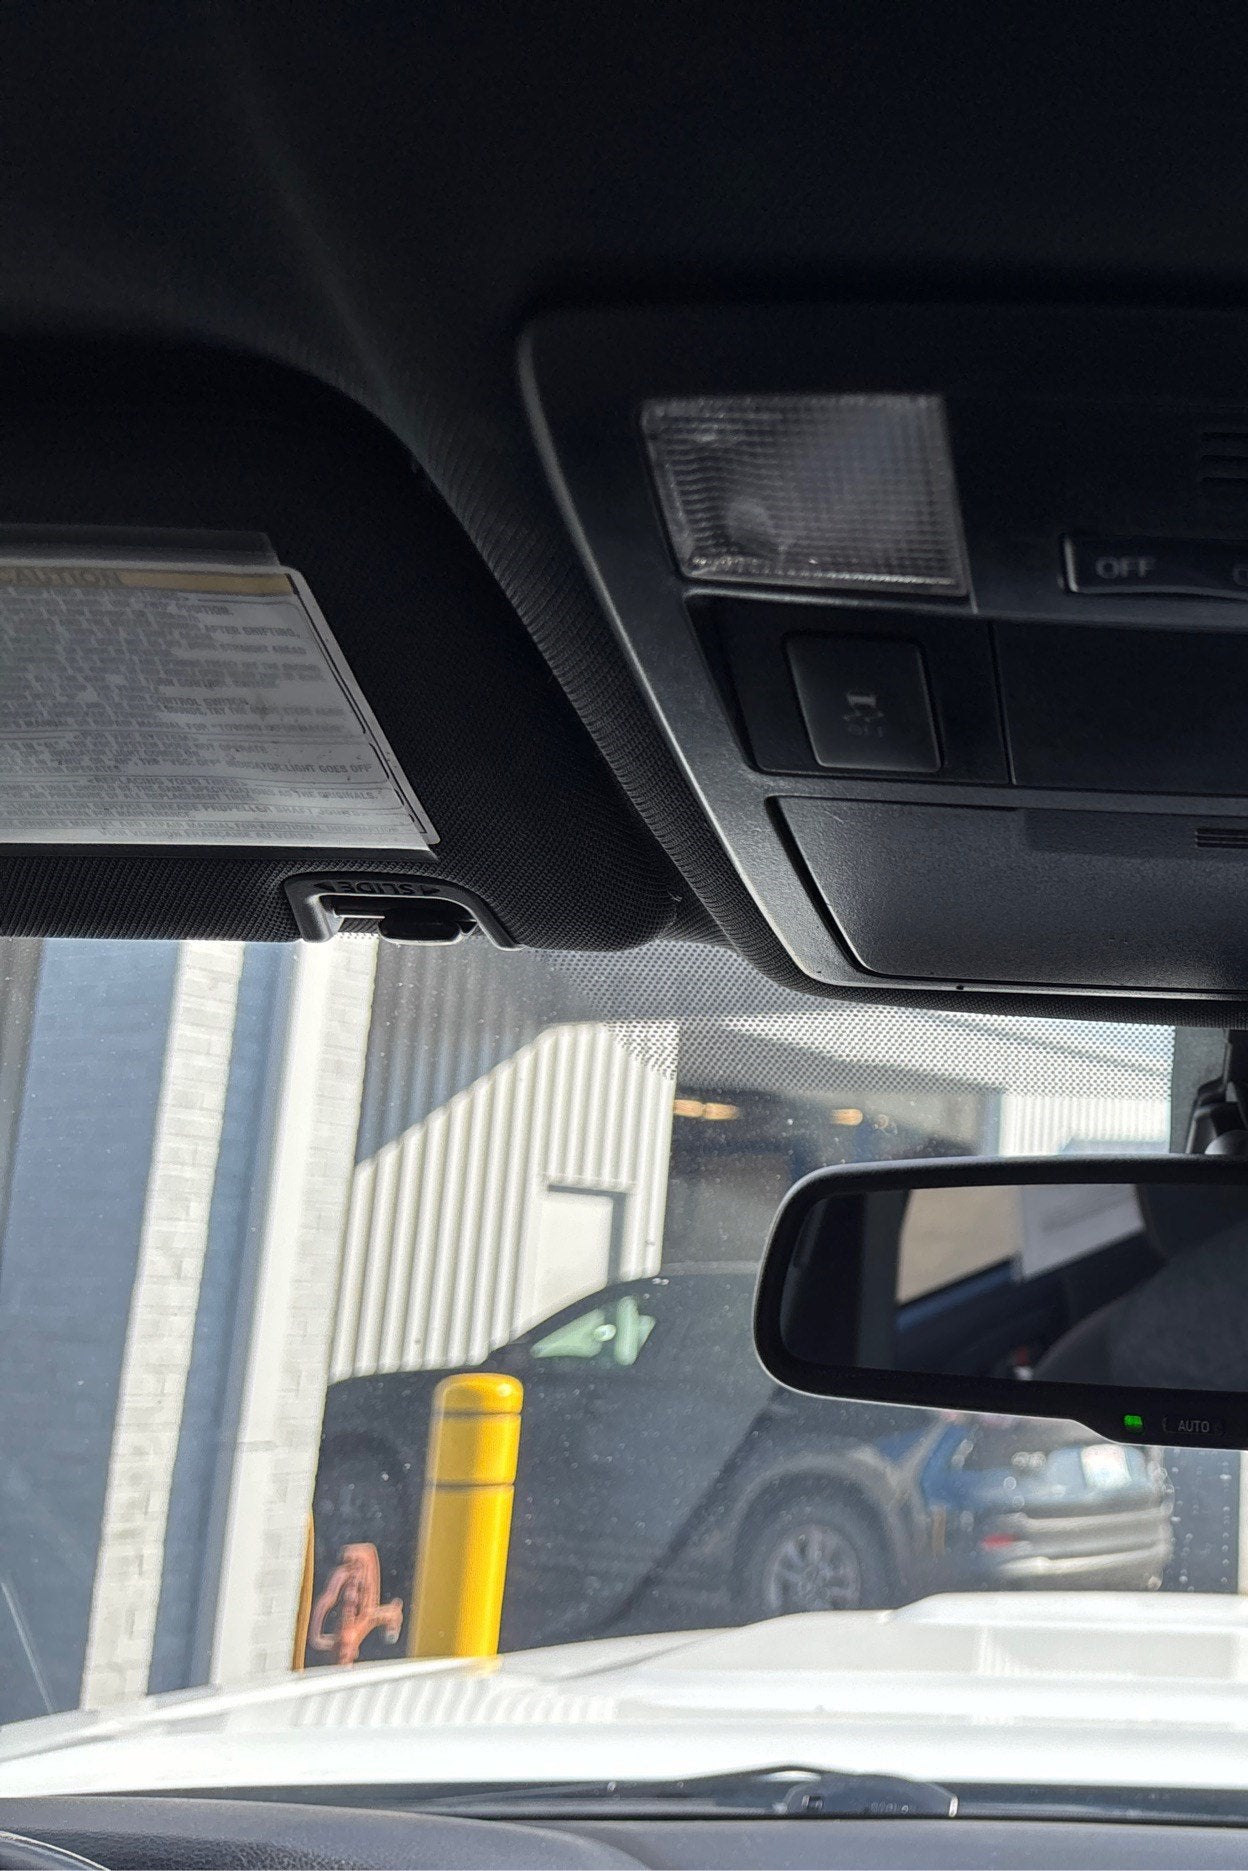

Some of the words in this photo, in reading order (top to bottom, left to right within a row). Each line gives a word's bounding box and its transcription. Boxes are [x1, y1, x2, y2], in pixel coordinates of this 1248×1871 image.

[1095, 556, 1157, 579] OFF
[6, 569, 124, 587] CAUTION
[284, 763, 316, 773] LIGHT
[318, 764, 348, 774] GOES
[168, 776, 201, 786] YOUR
[1177, 1420, 1210, 1432] AUTO
